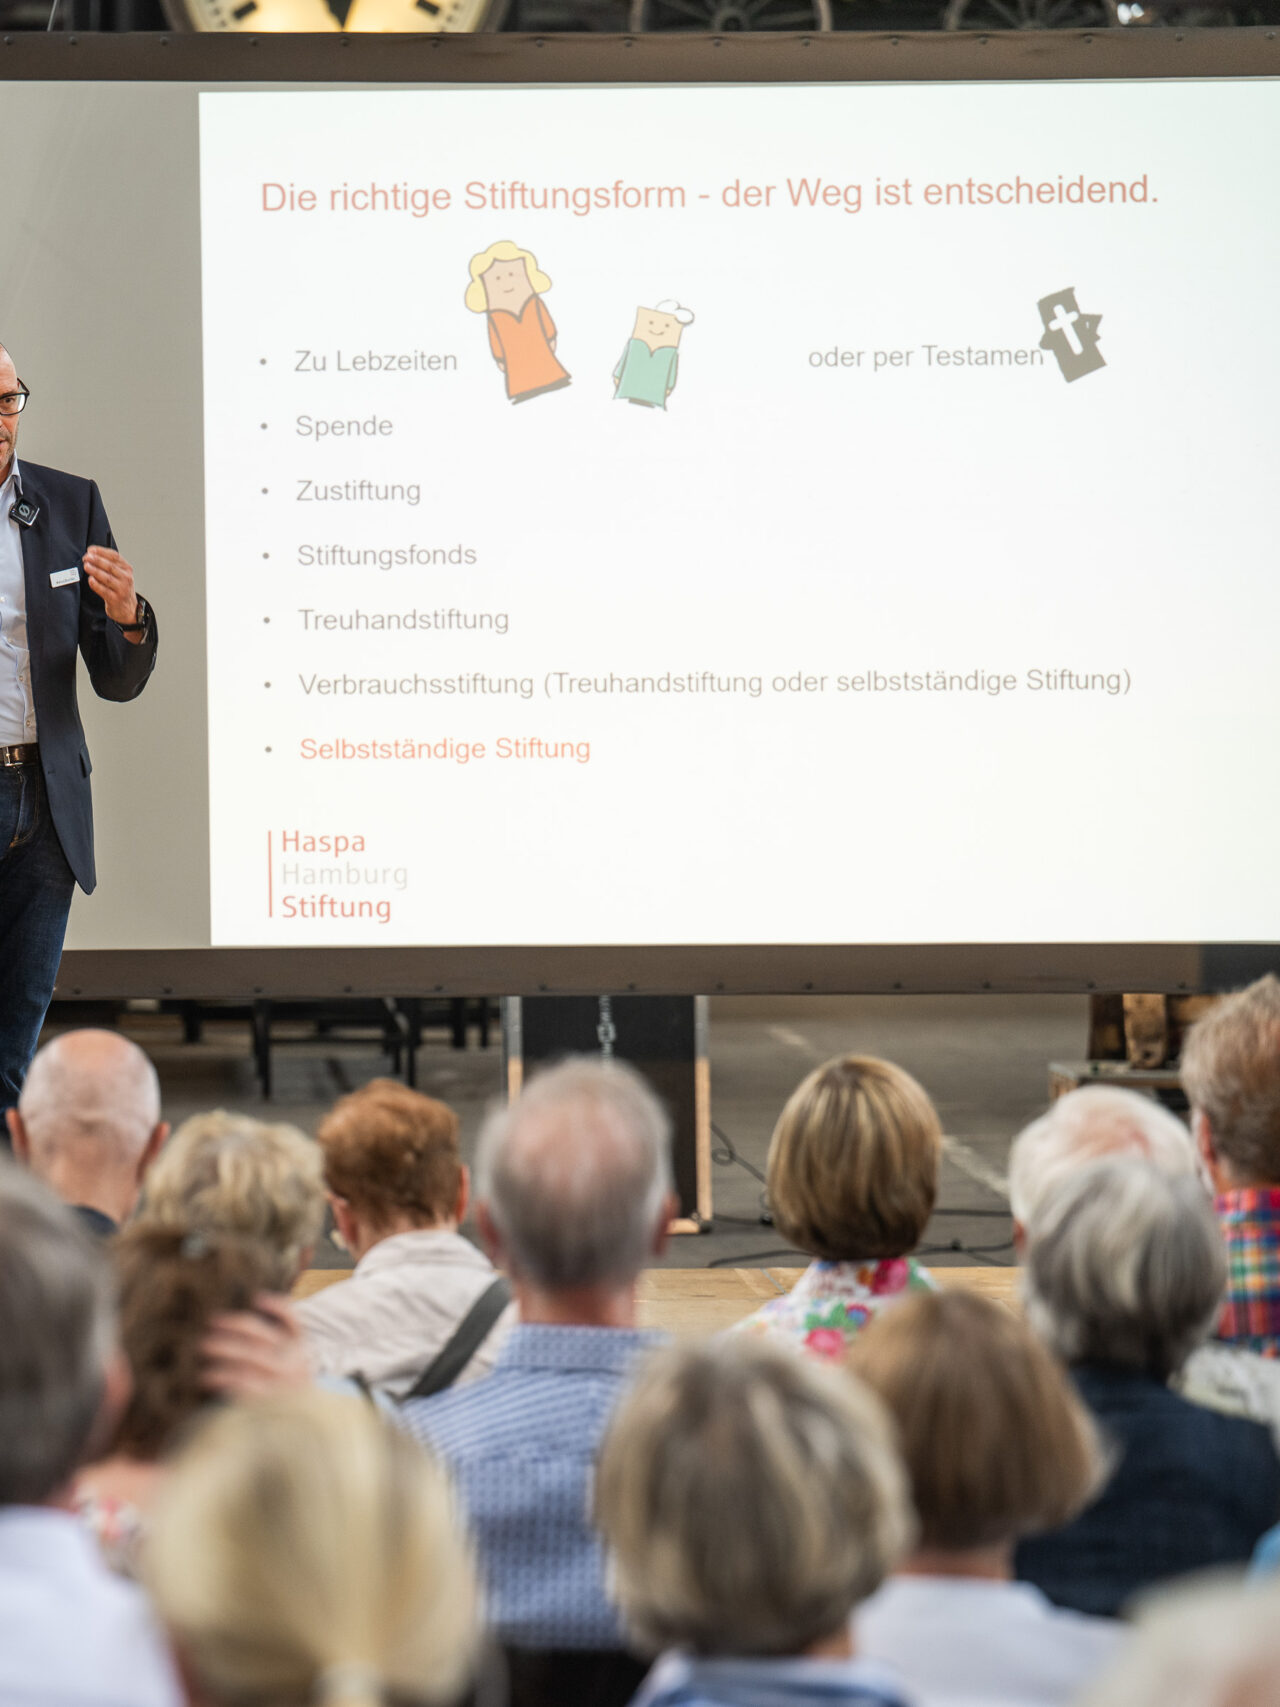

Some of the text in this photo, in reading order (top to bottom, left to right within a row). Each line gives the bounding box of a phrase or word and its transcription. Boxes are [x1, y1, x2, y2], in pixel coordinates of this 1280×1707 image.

[262, 183, 317, 211] Die
[331, 182, 451, 218] richtige
[464, 180, 685, 216] Stiftungsform
[722, 179, 776, 207] der
[787, 178, 861, 214] Weg
[876, 177, 912, 205] ist
[924, 174, 1158, 205] entscheidend.
[294, 350, 457, 372] Zu Lebzeiten
[809, 346, 865, 367] oder
[874, 350, 914, 372] per
[296, 415, 393, 442] Spende
[296, 480, 420, 506] Zustiftung
[298, 544, 477, 570] Stiftungsfonds
[298, 608, 508, 634] Treuhandstiftung
[299, 669, 1131, 699] Verbrauchsstiftung (Treuhandstiftung oder selbstständige Stiftung)
[300, 737, 590, 764] Selbstständige Stiftung
[283, 830, 365, 858] Haspa
[283, 861, 407, 890] Hamburg
[283, 894, 390, 924] Stiftung
